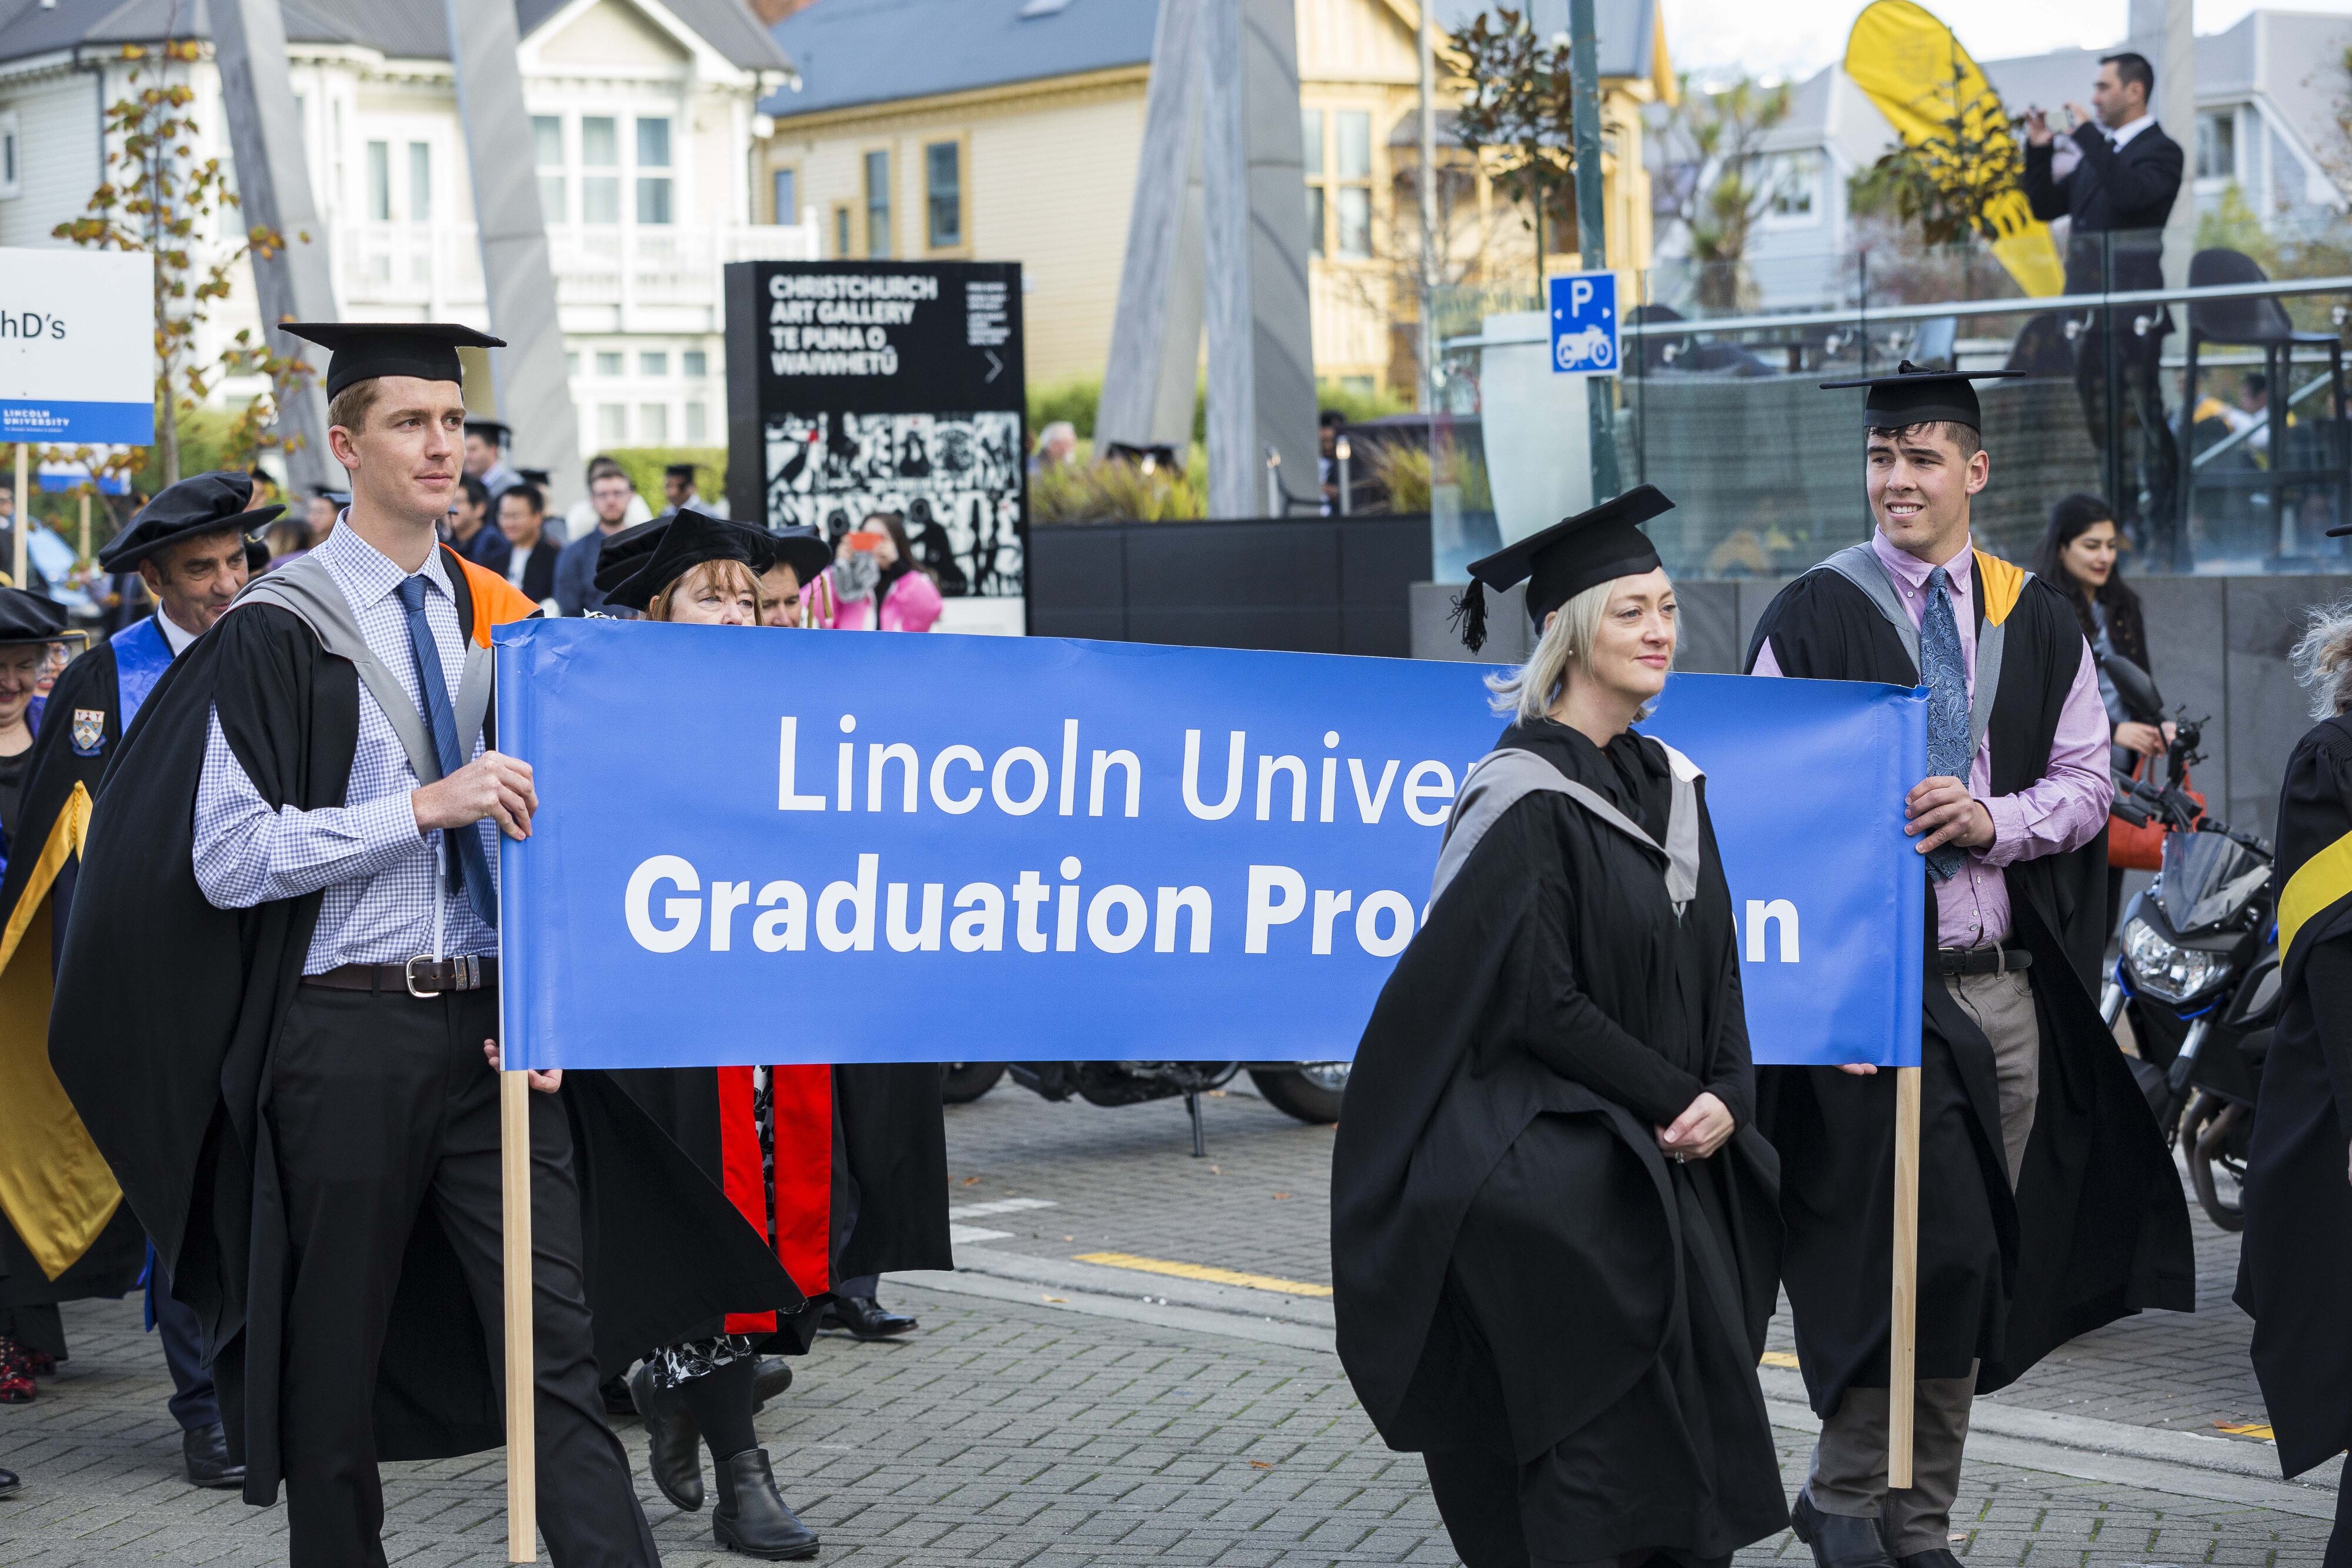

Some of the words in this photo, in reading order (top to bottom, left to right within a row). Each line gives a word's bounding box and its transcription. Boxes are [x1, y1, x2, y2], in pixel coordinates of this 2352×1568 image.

[769, 273, 938, 300] CHRISTCHURCH
[1571, 279, 1593, 318] P
[770, 300, 816, 323] ART
[816, 300, 916, 324] GALLERY
[769, 326, 799, 350] TE
[800, 326, 866, 351] PUNA
[865, 325, 887, 350] O
[779, 715, 1141, 817] Lincoln
[1183, 729, 1477, 826] Unive
[625, 853, 1212, 953] Graduation
[1245, 865, 1430, 958] Pro
